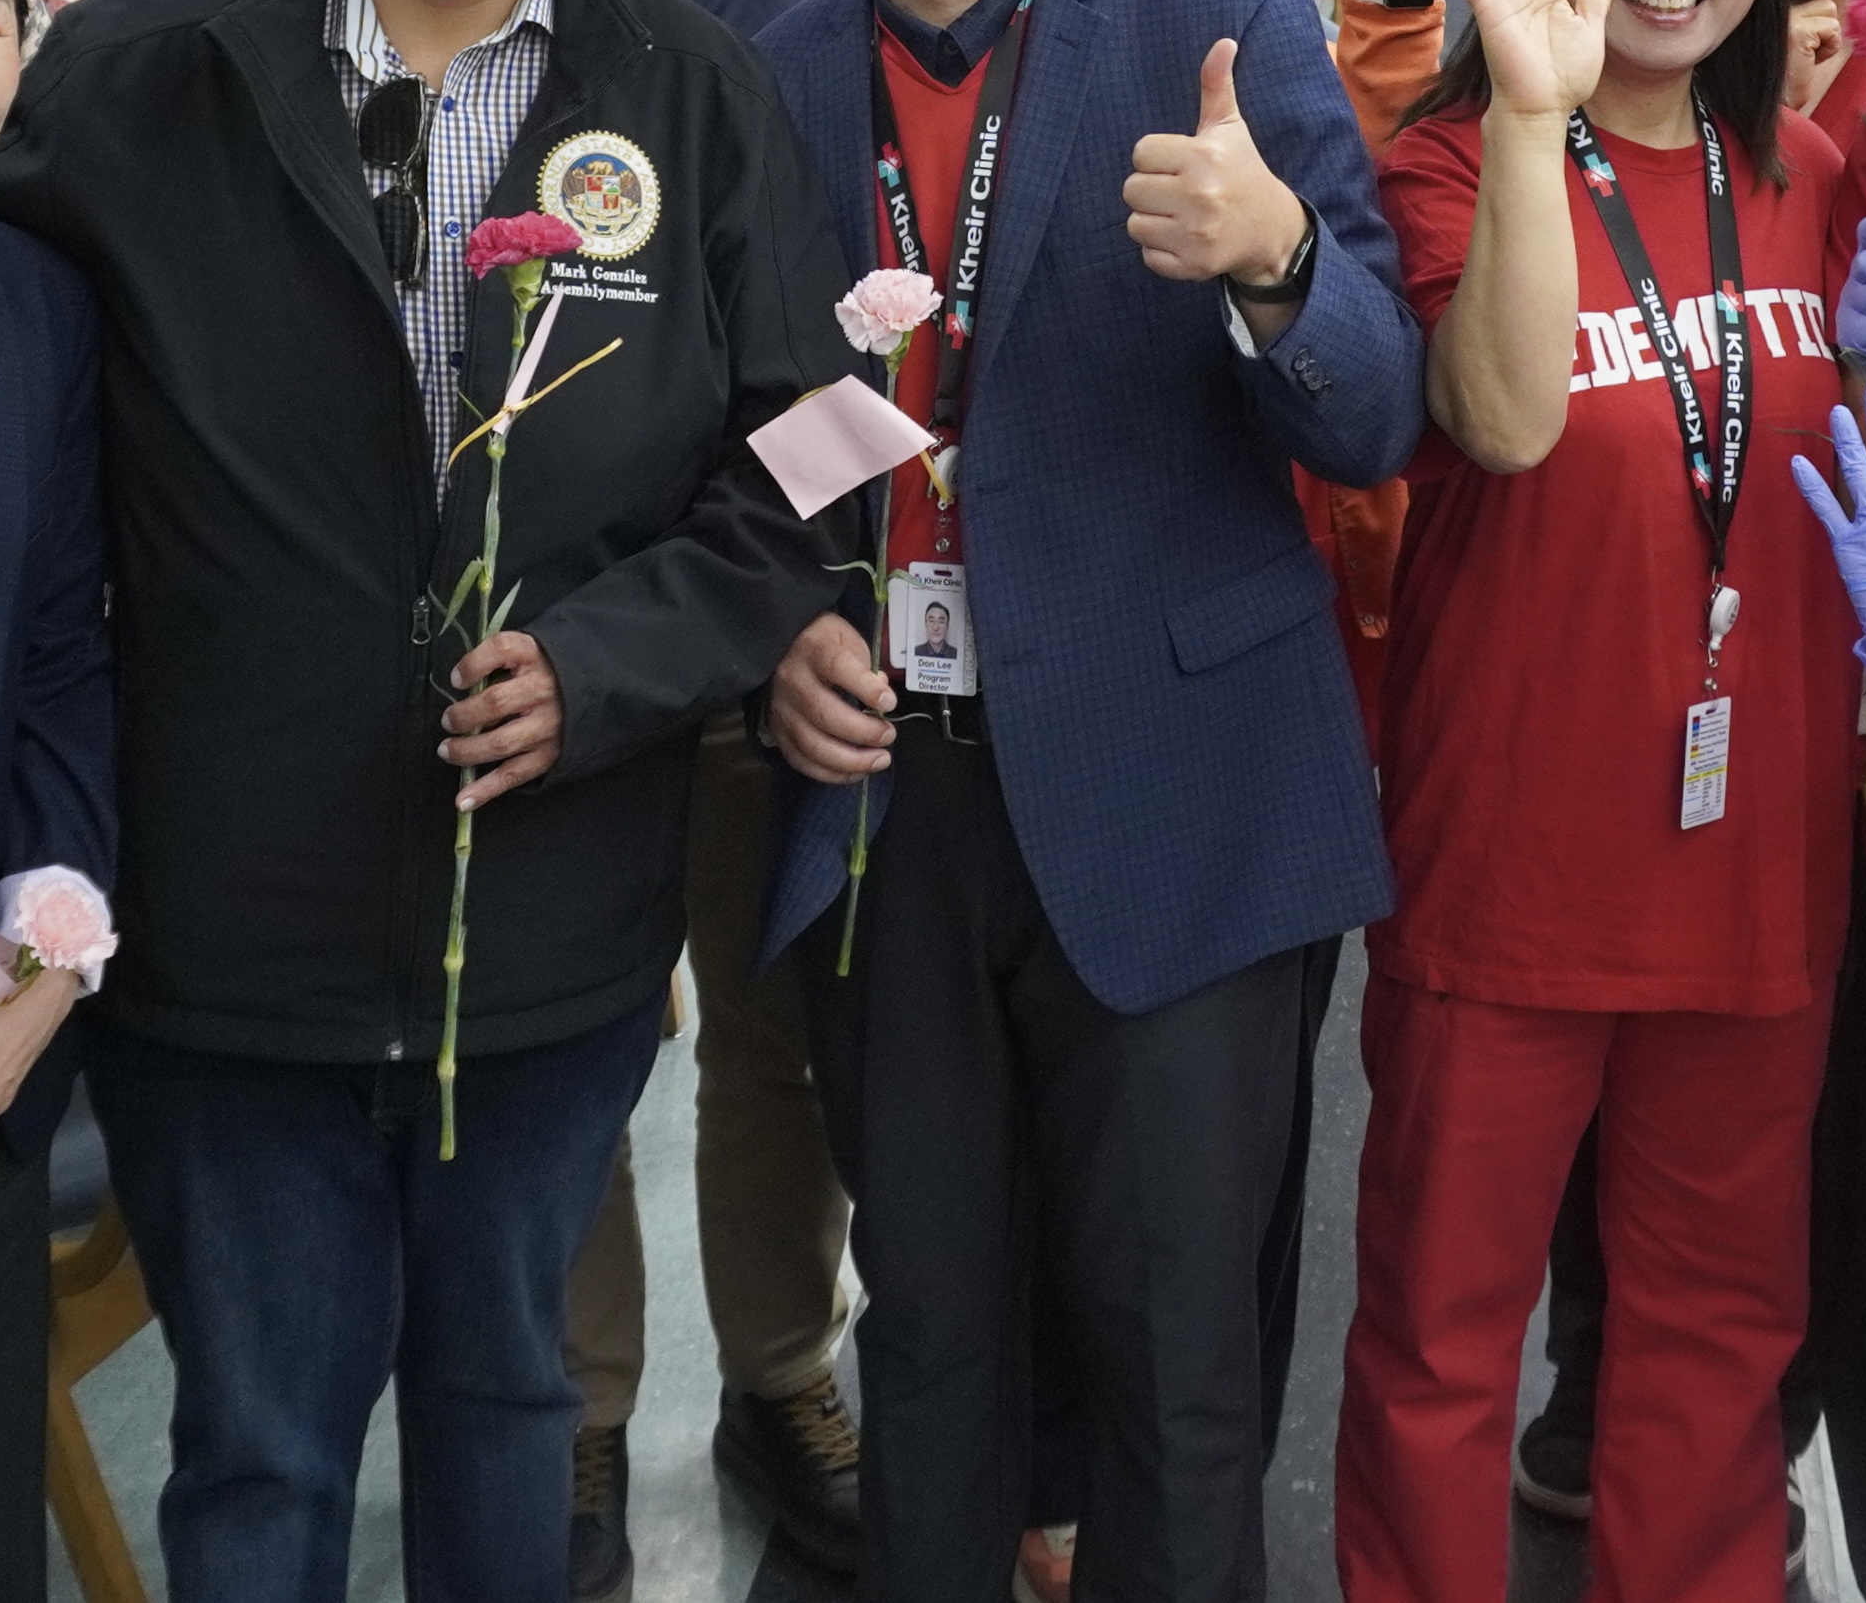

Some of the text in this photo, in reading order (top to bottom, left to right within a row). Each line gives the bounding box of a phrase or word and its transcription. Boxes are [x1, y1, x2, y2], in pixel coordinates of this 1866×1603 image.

[1702, 121, 1724, 197] Clinic
[890, 192, 920, 274] Kheir
[956, 115, 1001, 292] Kheir Clinic
[550, 262, 648, 284] Mark González
[1641, 277, 1703, 443] Kheir Clinic
[1722, 332, 1744, 504] Kheir Clinic
[918, 659, 952, 670] Don Lee
[918, 673, 951, 684] Program
[919, 682, 950, 692] Director
